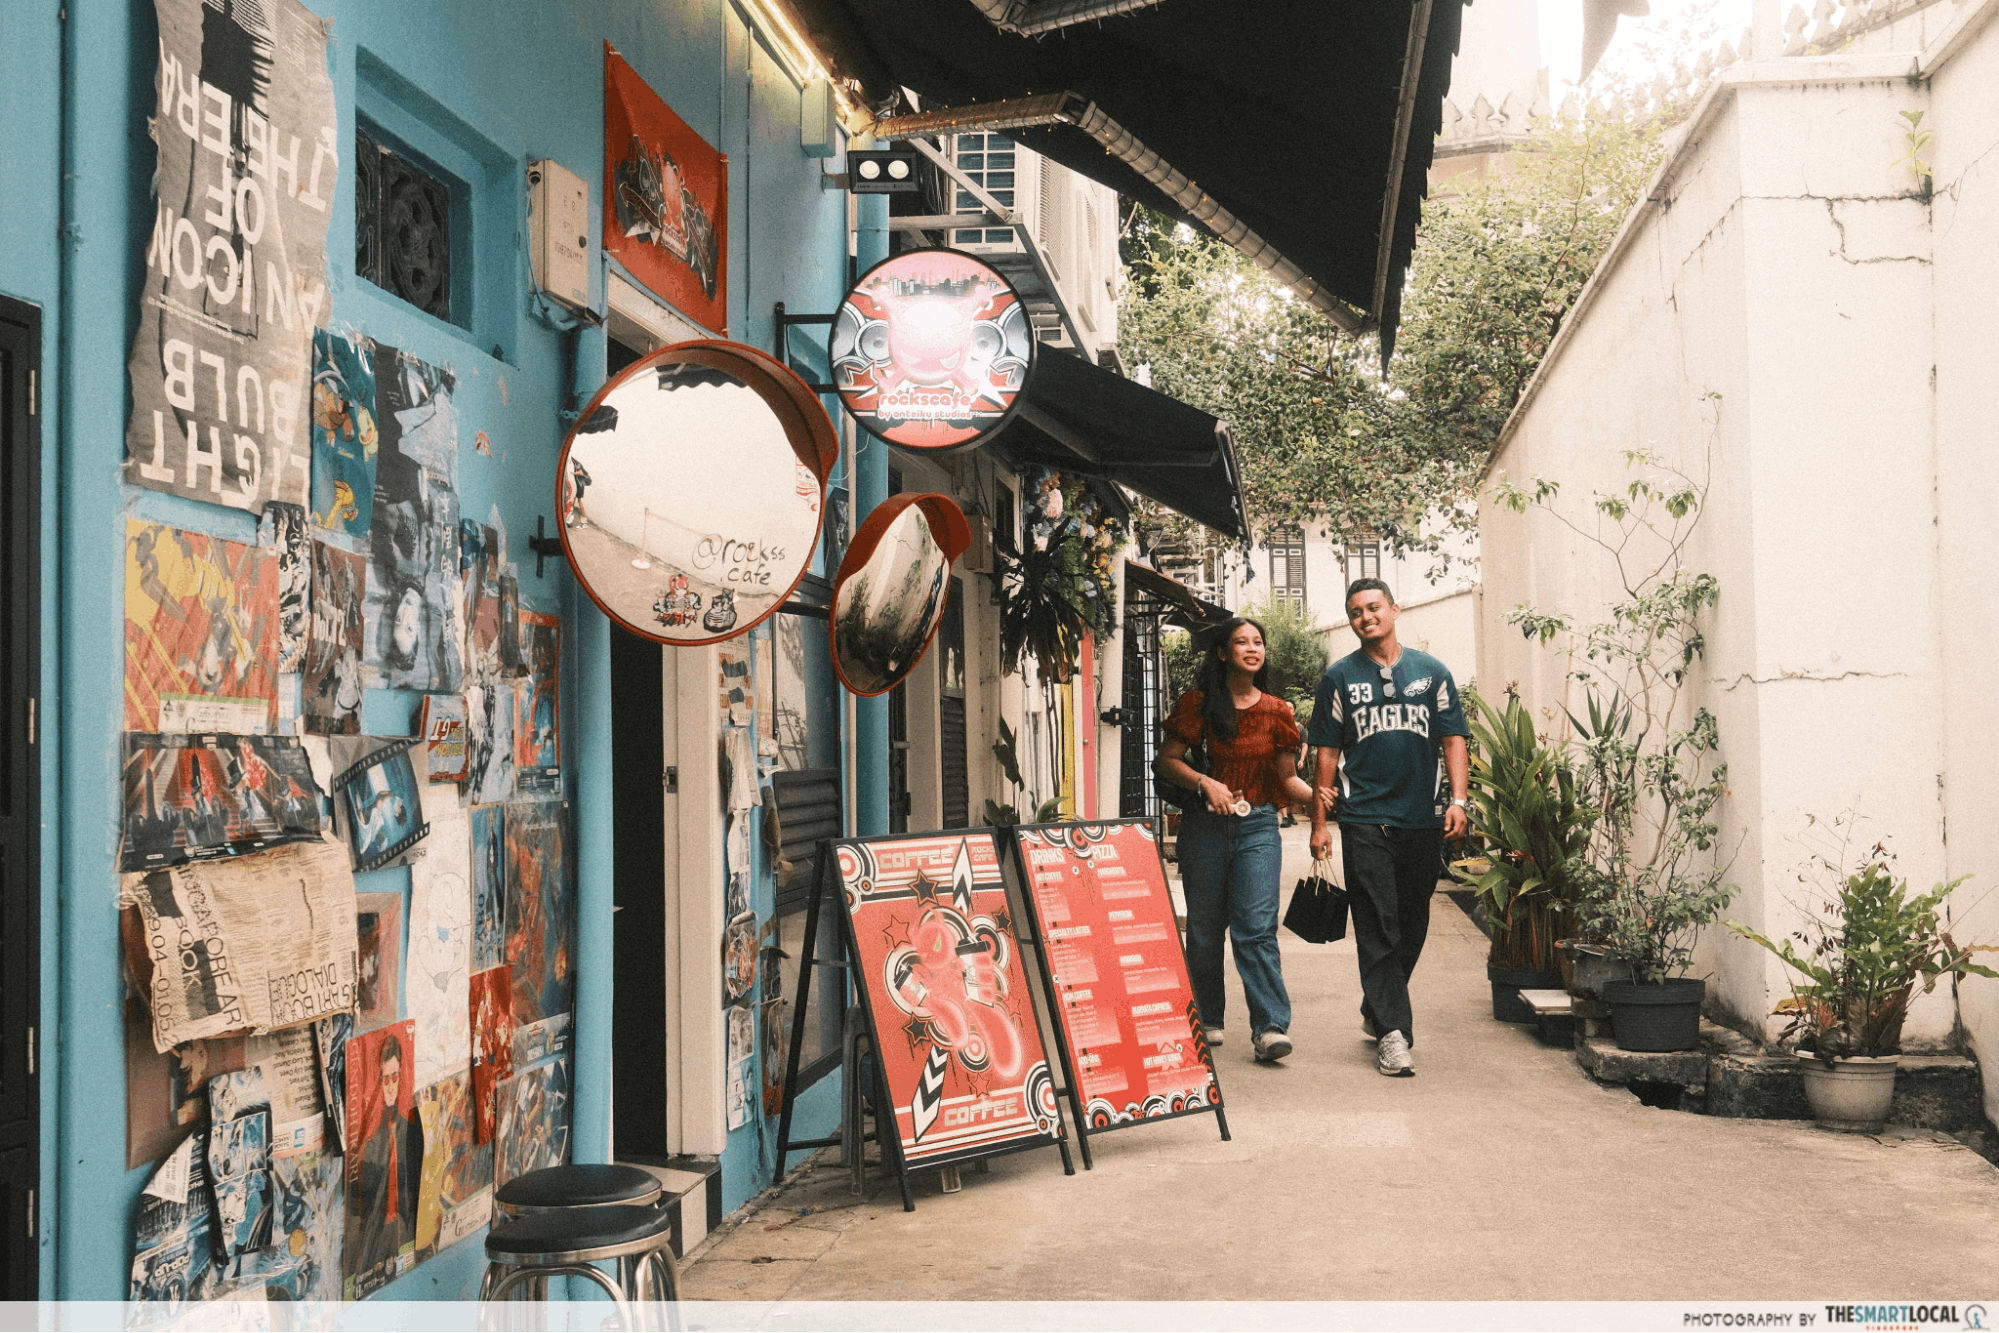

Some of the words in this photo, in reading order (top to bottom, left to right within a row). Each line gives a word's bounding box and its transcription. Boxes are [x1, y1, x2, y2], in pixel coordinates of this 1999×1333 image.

[159, 36, 232, 159] ERA
[248, 106, 327, 213] THE
[205, 157, 265, 245] OF
[148, 197, 250, 313] ICON
[266, 261, 325, 339] AN
[163, 338, 298, 446] BULB
[879, 392, 971, 409] rockscafe
[878, 410, 890, 420] by
[893, 410, 932, 418] anteiku
[934, 410, 971, 418] studios
[1348, 682, 1373, 705] 33
[1352, 703, 1430, 744] EAGLES
[879, 848, 955, 869] COFFEE
[1030, 848, 1065, 864] DRINKS
[1091, 844, 1118, 859] PIZZA
[173, 916, 204, 990] BOOK
[945, 1097, 1018, 1127] COFFEE
